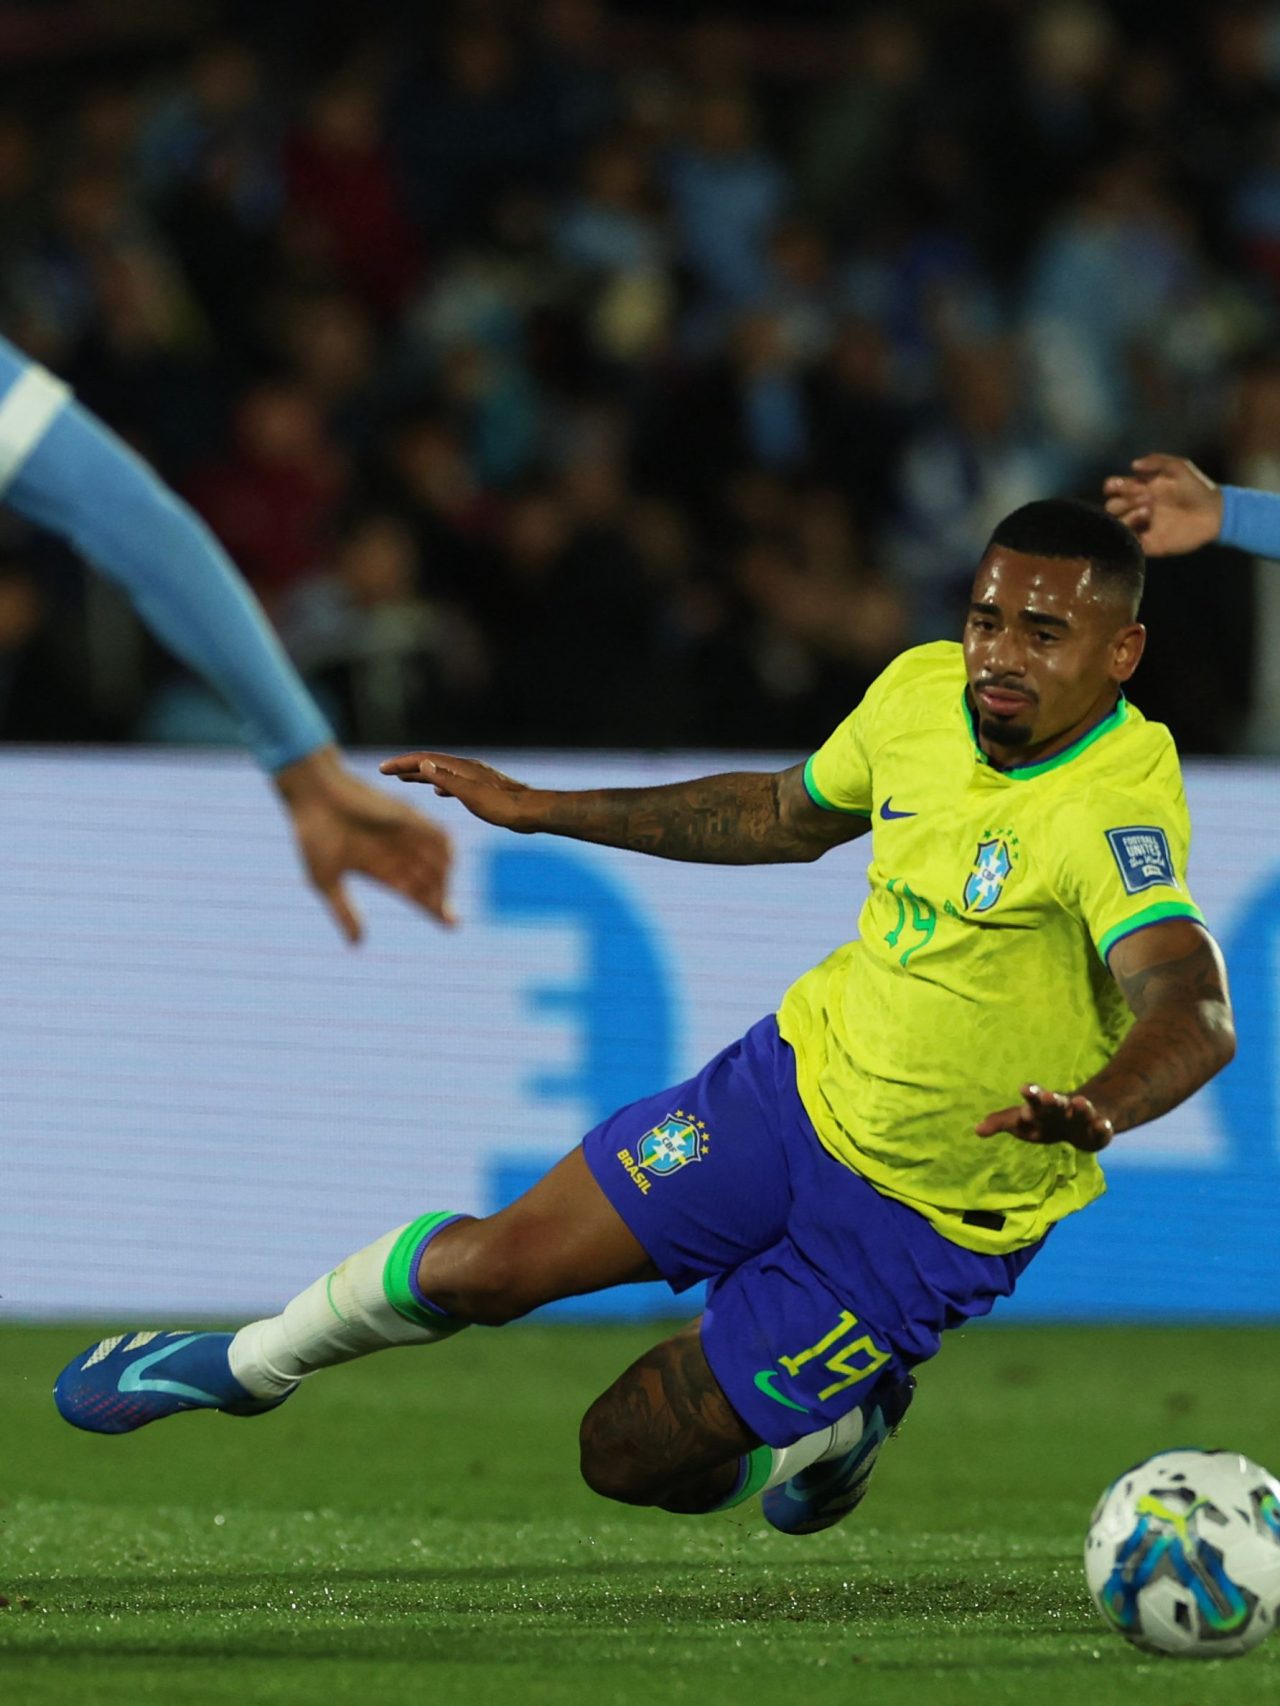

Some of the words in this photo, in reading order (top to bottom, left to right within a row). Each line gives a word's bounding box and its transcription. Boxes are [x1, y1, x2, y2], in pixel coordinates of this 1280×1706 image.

[884, 878, 937, 968] 19
[617, 1149, 651, 1195] BRASIL
[662, 1137, 677, 1154] CBF
[777, 1309, 892, 1401] 19
